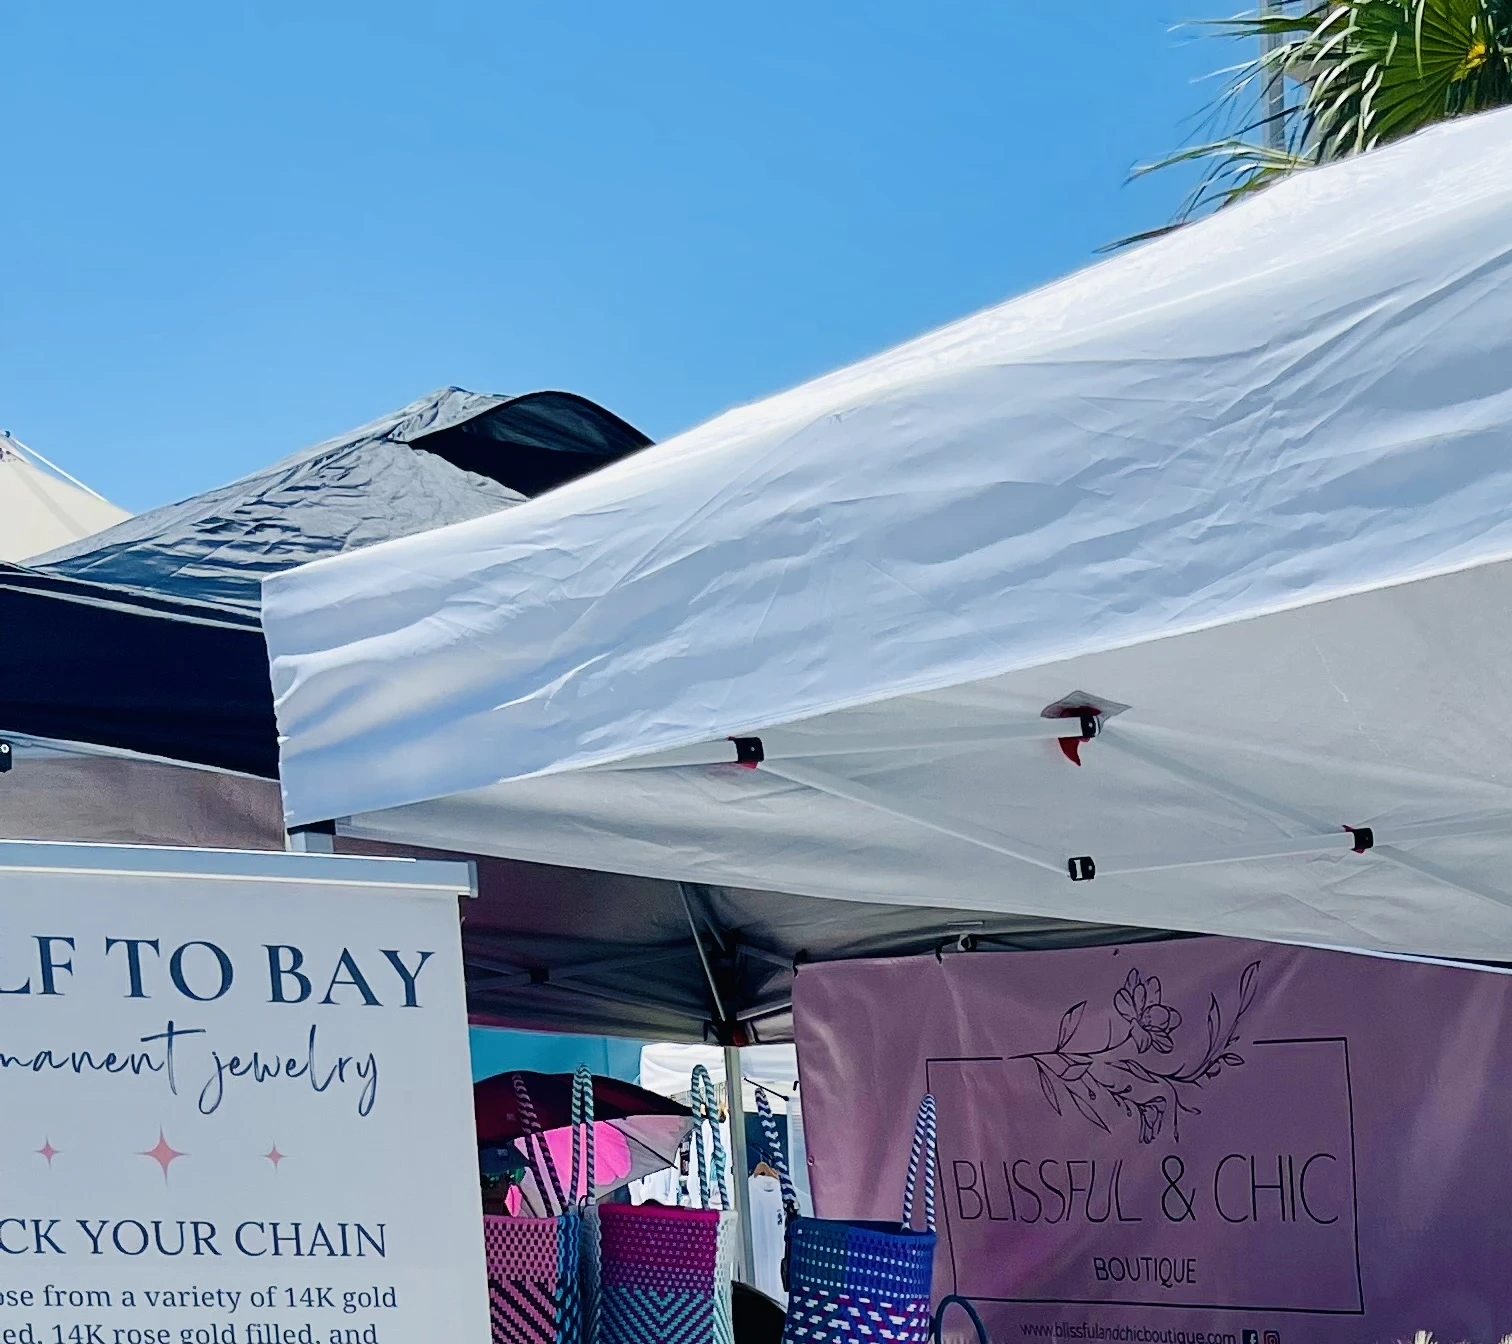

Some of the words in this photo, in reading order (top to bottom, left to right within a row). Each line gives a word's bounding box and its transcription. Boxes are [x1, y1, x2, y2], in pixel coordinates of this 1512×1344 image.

[106, 937, 233, 1001] TO
[263, 945, 435, 1007] BAY
[195, 1024, 377, 1116] jewelry
[953, 1159, 1142, 1225] BLISSFUL
[1162, 1155, 1196, 1222] &
[1215, 1153, 1338, 1224] CHIC
[0, 1219, 66, 1254] CK
[76, 1220, 222, 1255] YOUR
[236, 1222, 385, 1257] CHAIN
[1093, 1256, 1196, 1290] BOUTIQUE
[43, 1285, 112, 1306] from
[122, 1291, 136, 1306] a
[144, 1286, 241, 1313] variety
[251, 1286, 277, 1307] of
[285, 1288, 335, 1307] 14K
[343, 1287, 397, 1313] gold
[52, 1325, 105, 1344] 14K
[113, 1330, 170, 1344] rose
[330, 1324, 378, 1344] and
